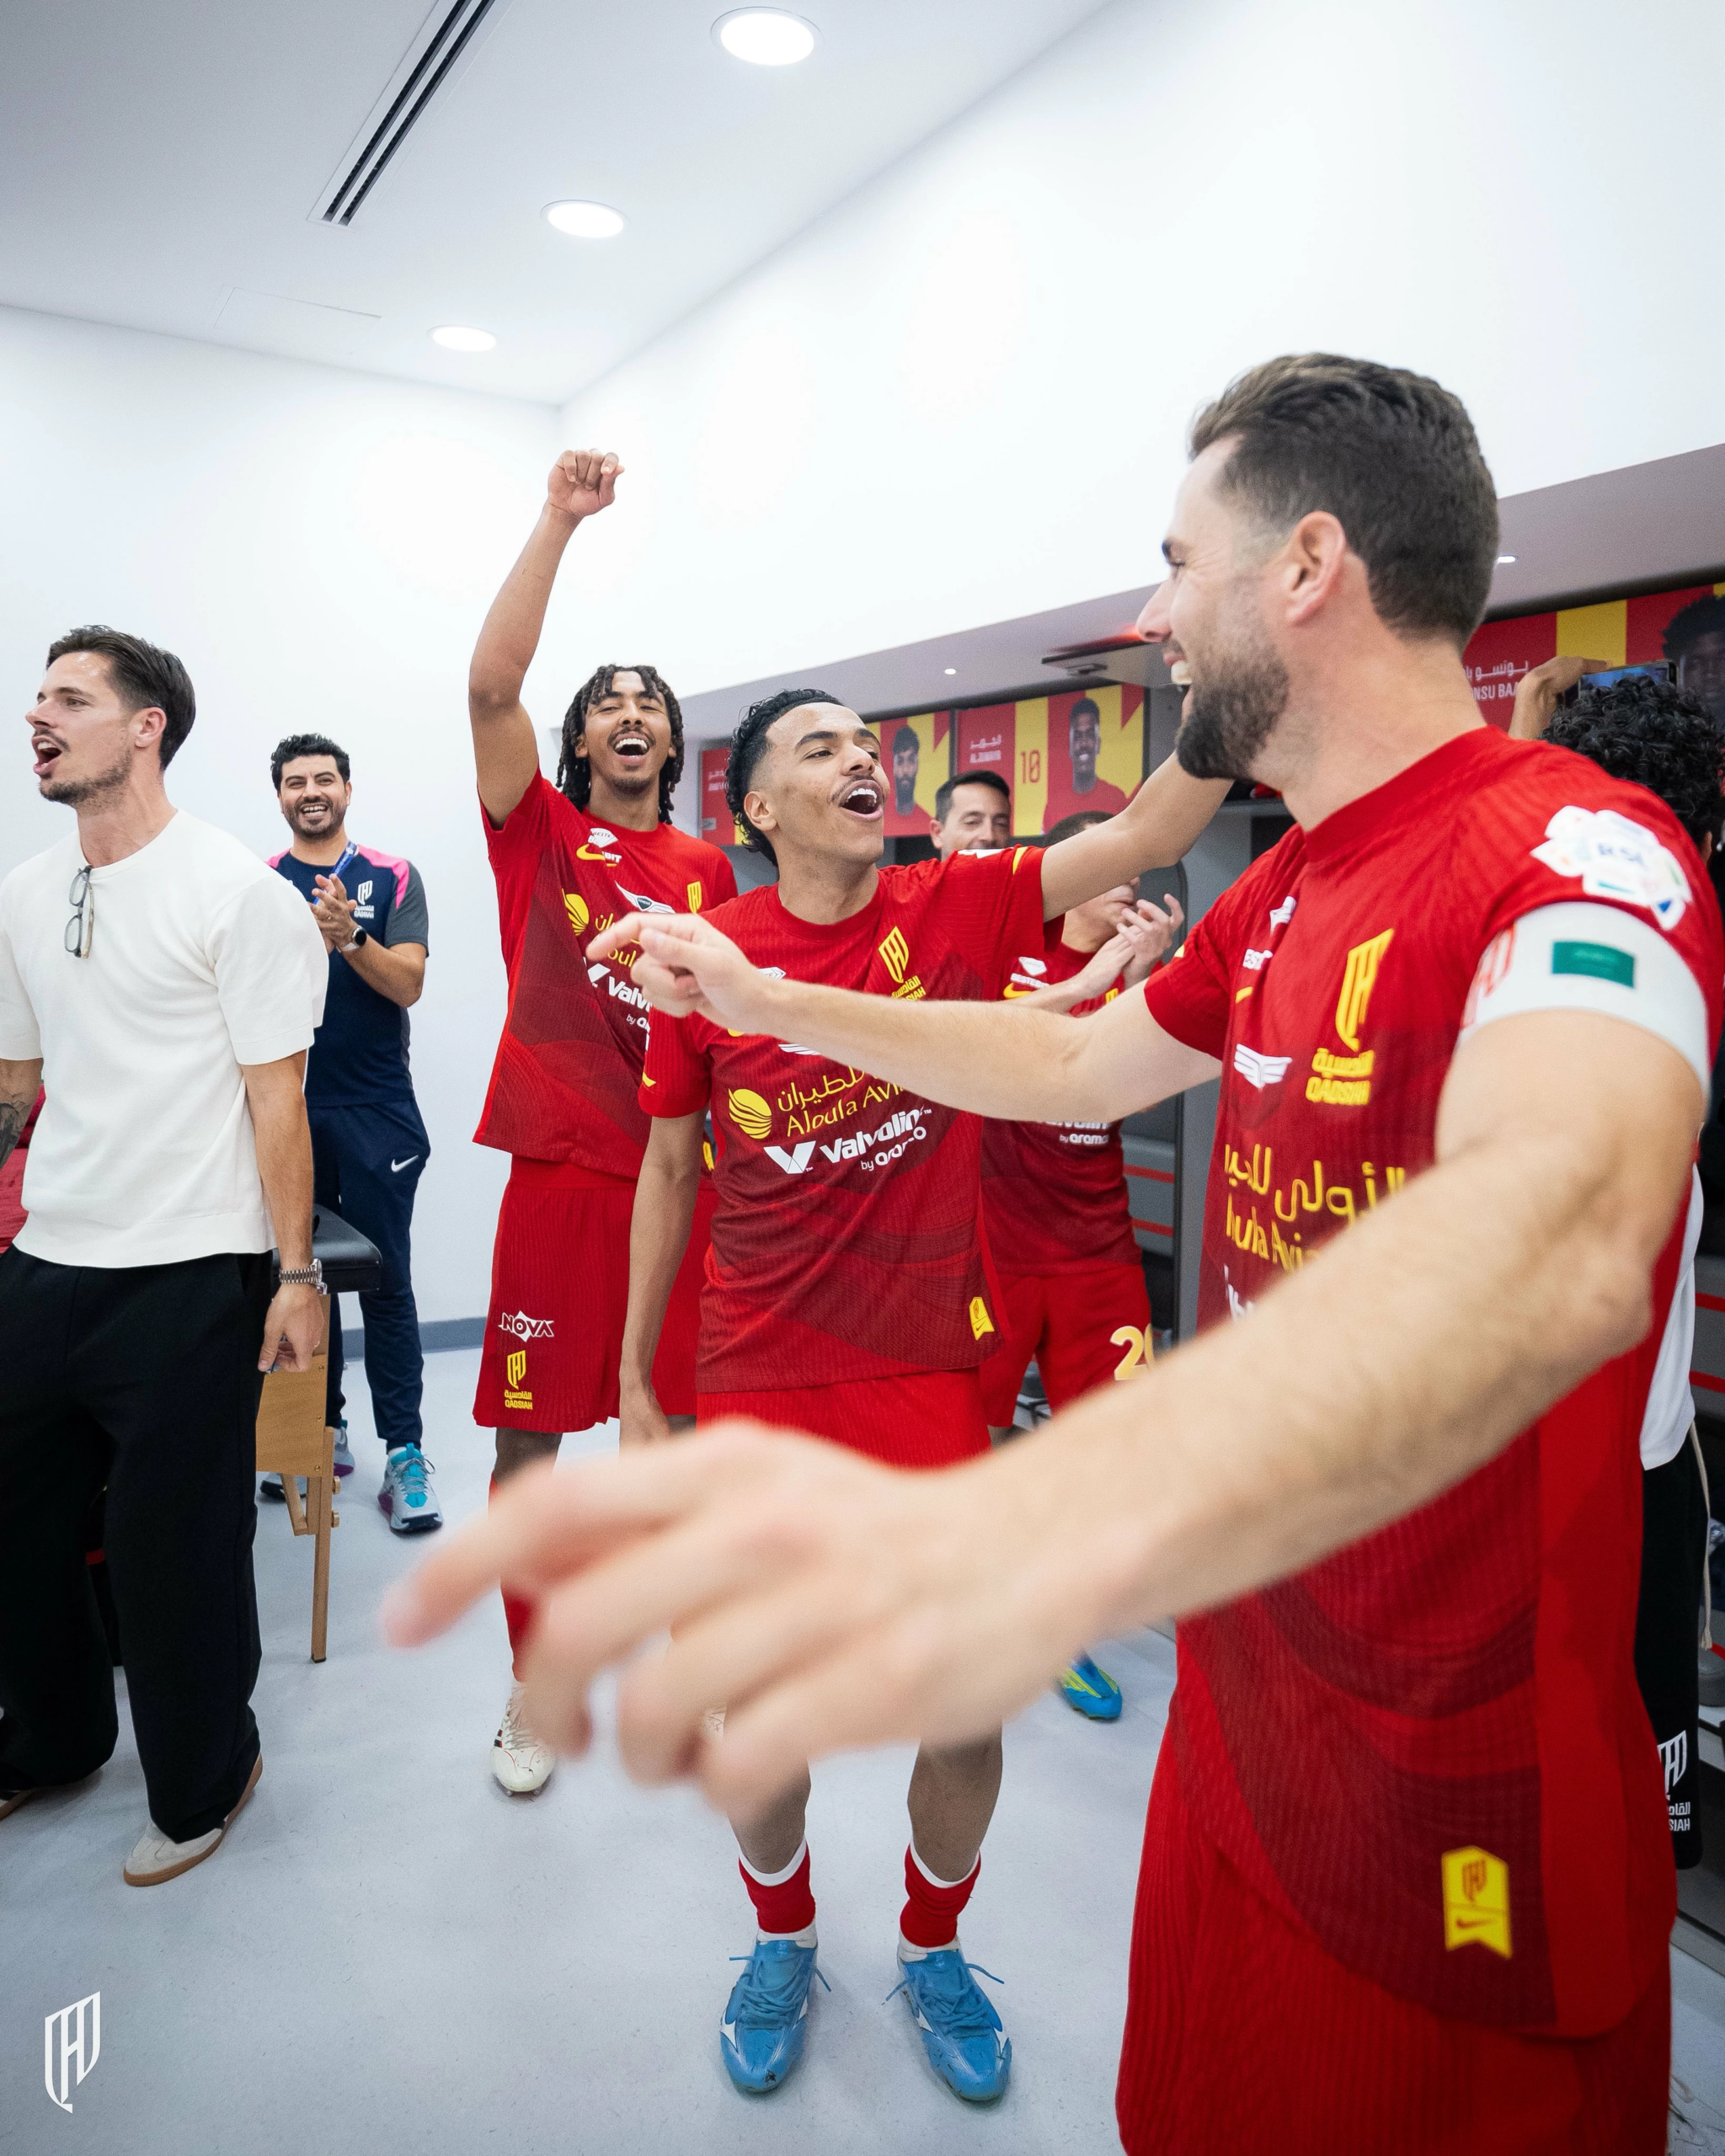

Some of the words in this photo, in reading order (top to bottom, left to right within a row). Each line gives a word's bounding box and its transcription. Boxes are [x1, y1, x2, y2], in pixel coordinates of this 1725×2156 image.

[1471, 684, 1495, 700] NSU
[1020, 748, 1041, 785] 10
[626, 1013, 635, 1025] by
[787, 1098, 858, 1138] Aloula
[819, 1107, 926, 1164] Valvolin
[1059, 1134, 1068, 1143] by
[861, 1160, 873, 1171] by
[501, 1311, 556, 1338] NOVA
[505, 1399, 533, 1410] QADSIAH
[1669, 1817, 1690, 1831] SIAH
